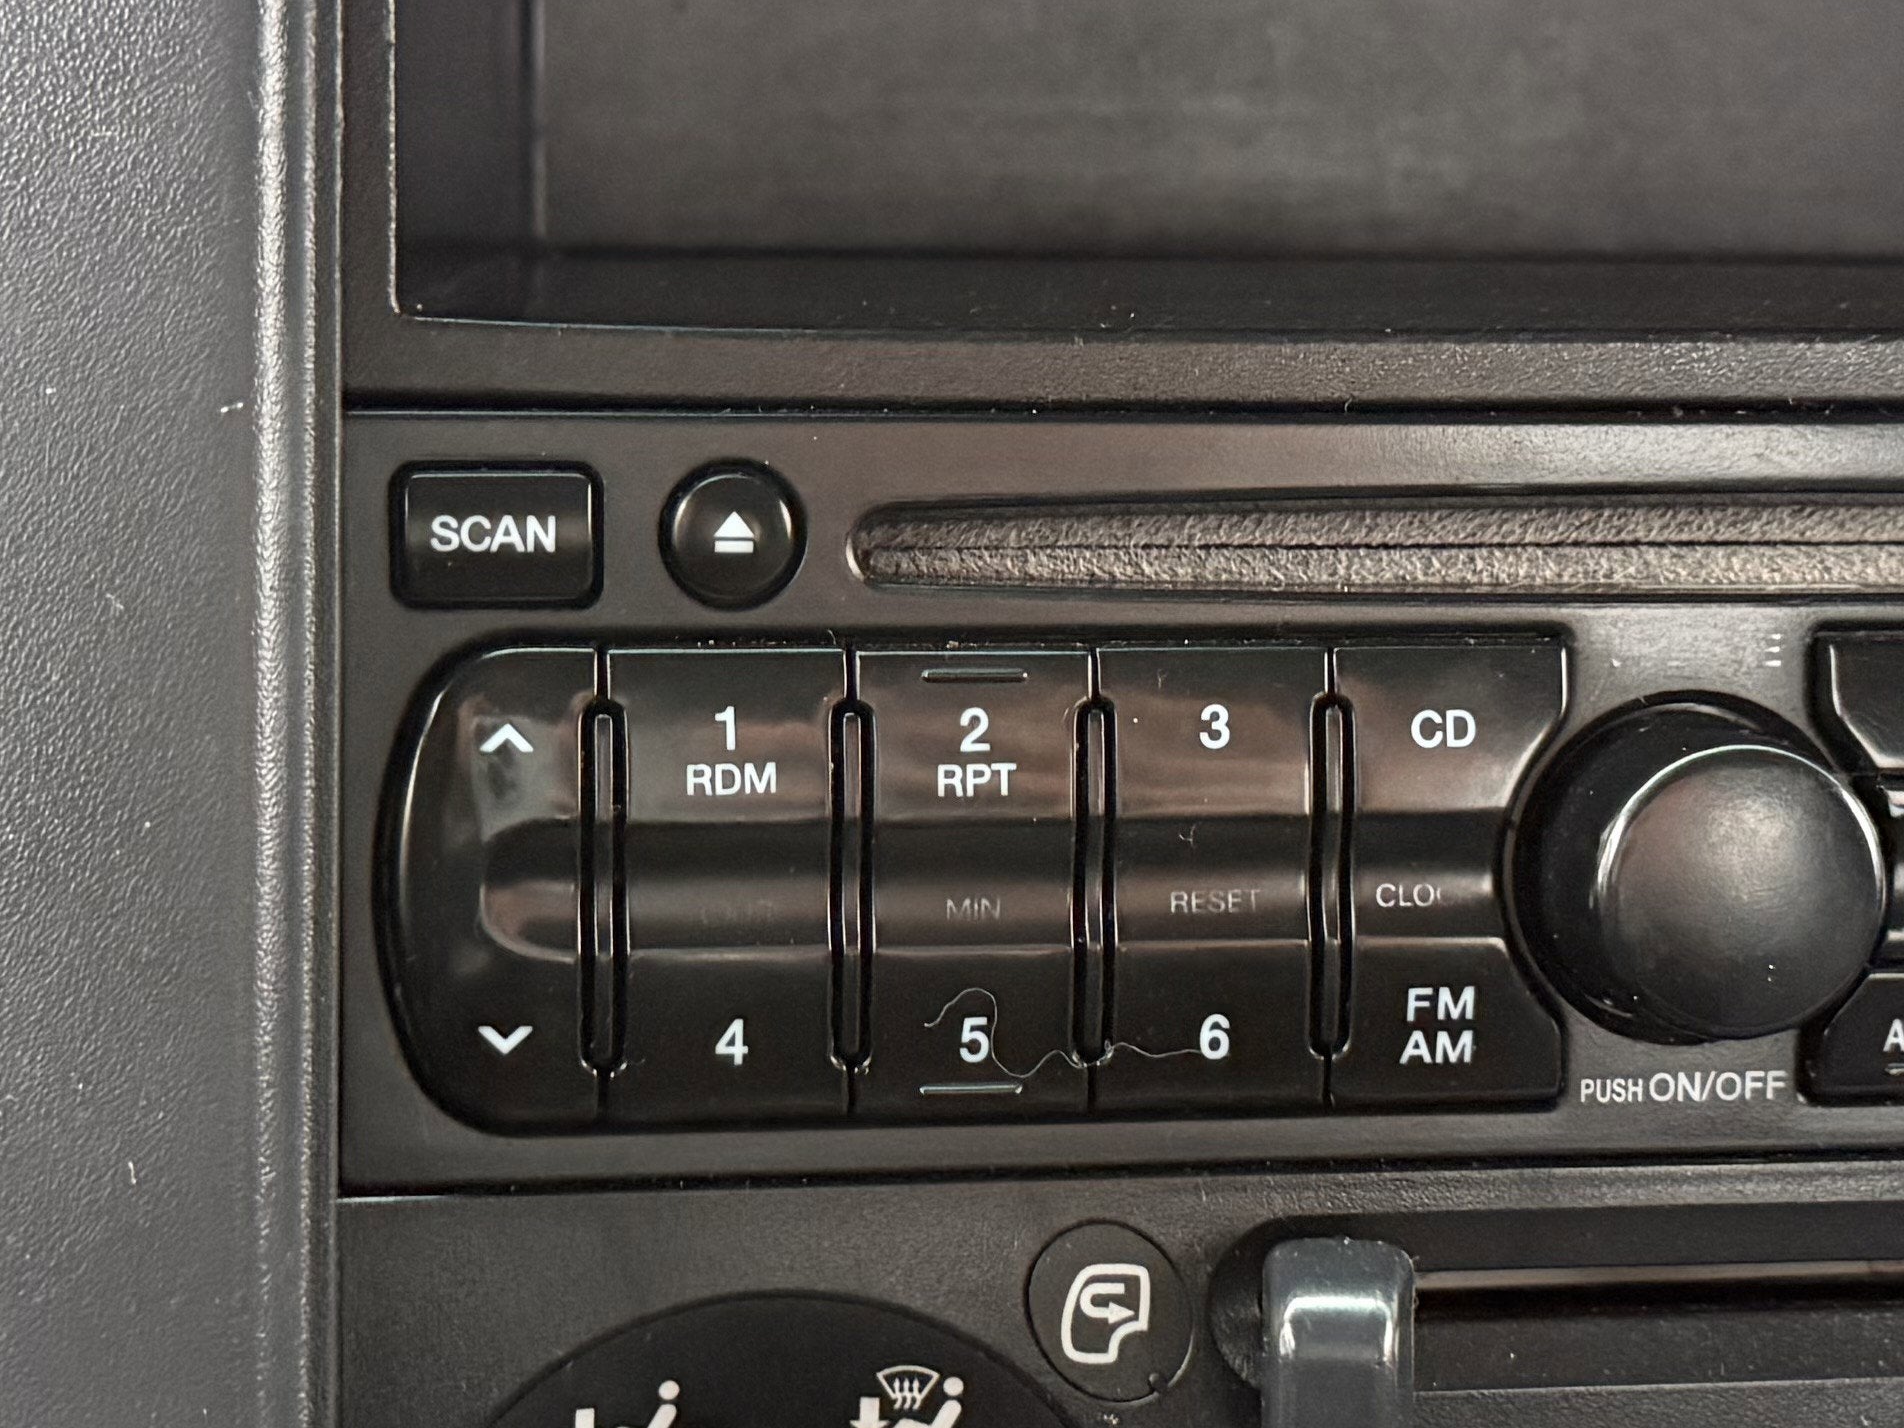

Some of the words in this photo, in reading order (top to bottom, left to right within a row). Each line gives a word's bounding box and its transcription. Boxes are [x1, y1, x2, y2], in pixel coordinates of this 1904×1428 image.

[430, 514, 557, 553] SCAN
[714, 705, 736, 751] 1
[959, 706, 991, 753] 2
[1199, 703, 1231, 750] 3
[1410, 709, 1477, 749] CD
[686, 761, 777, 796] RDM
[937, 762, 1017, 798] RPT
[946, 897, 1001, 919] MIN
[1170, 888, 1261, 913] RESET
[1375, 882, 1445, 908] CLO
[1406, 985, 1475, 1022] FM
[715, 1018, 749, 1066] 4
[959, 1016, 990, 1063] 5
[1199, 1013, 1230, 1060] 6
[1399, 1030, 1473, 1065] AM
[1580, 1077, 1644, 1104] PUSH
[1648, 1070, 1787, 1102] ON/OFF
